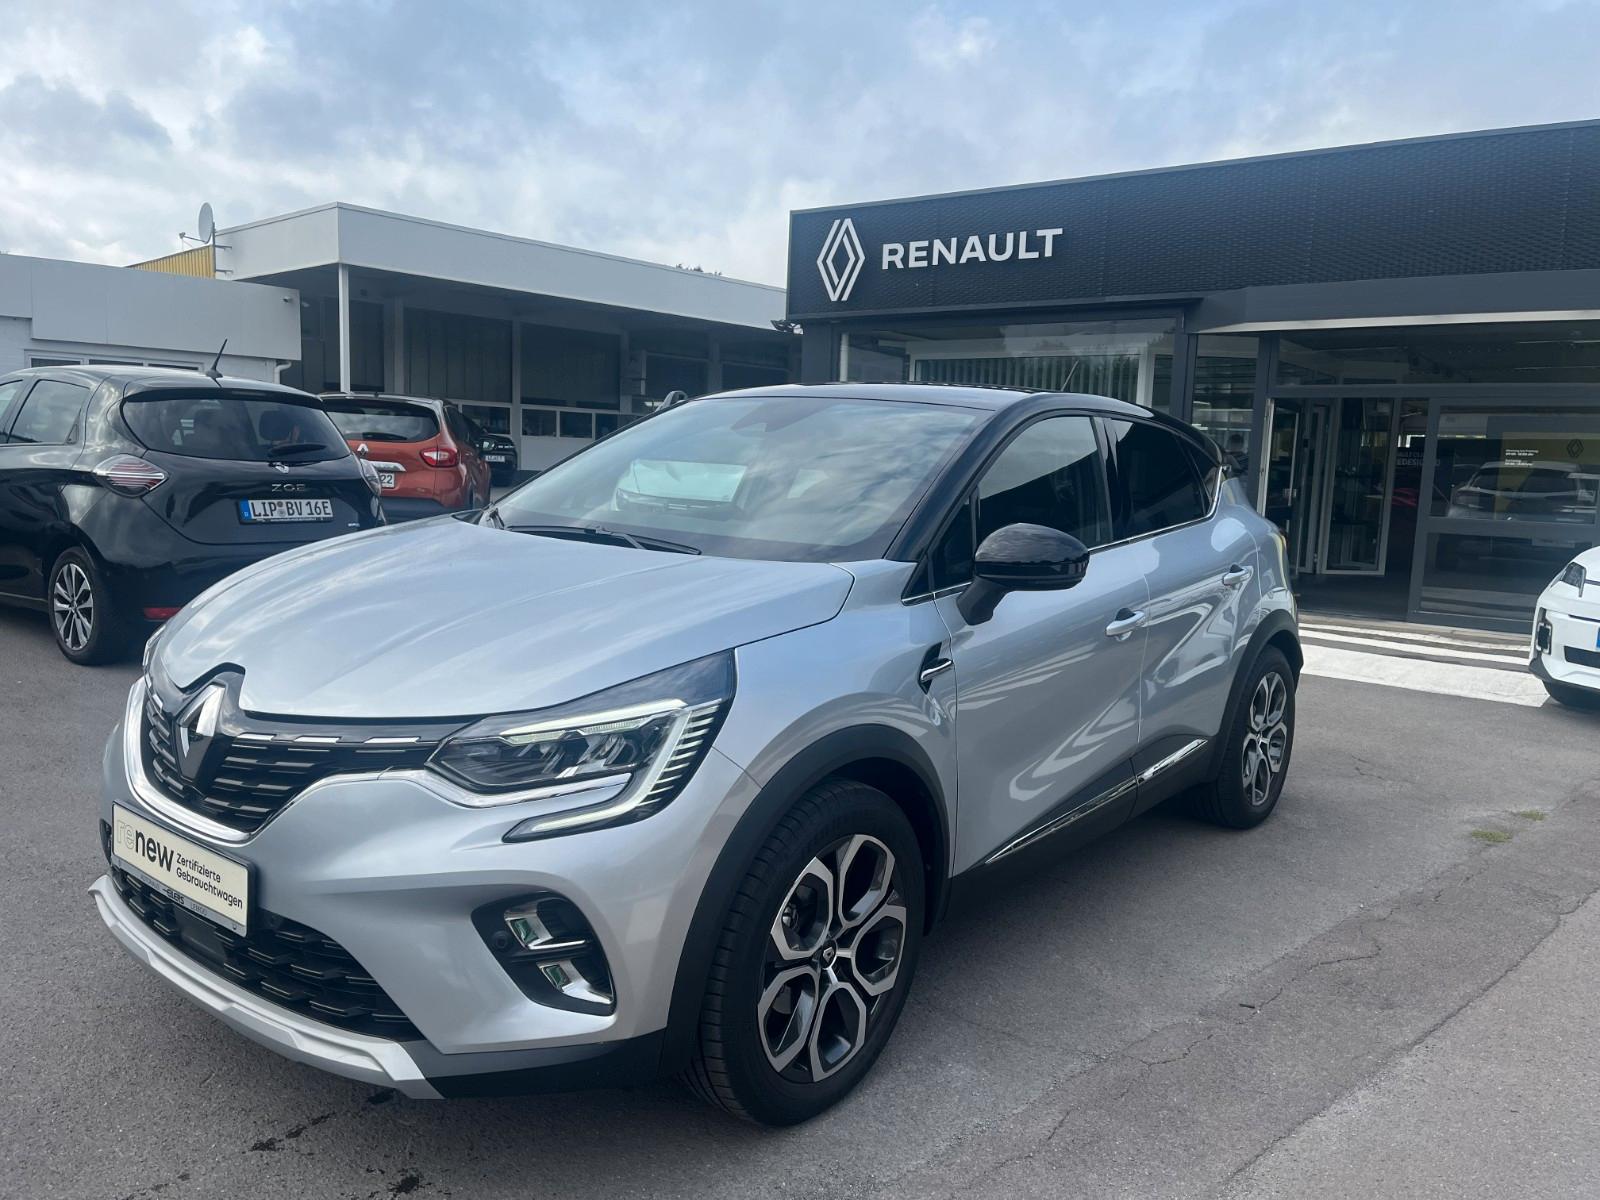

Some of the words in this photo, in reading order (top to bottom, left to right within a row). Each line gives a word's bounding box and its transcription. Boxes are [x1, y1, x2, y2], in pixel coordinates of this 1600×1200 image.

[882, 227, 1063, 270] RENAULT
[251, 501, 277, 517] LIP
[286, 501, 303, 516] BV
[305, 501, 331, 516] 16E
[176, 852, 221, 883] Zertifizierte
[176, 866, 243, 910] Gebrauchtwagen
